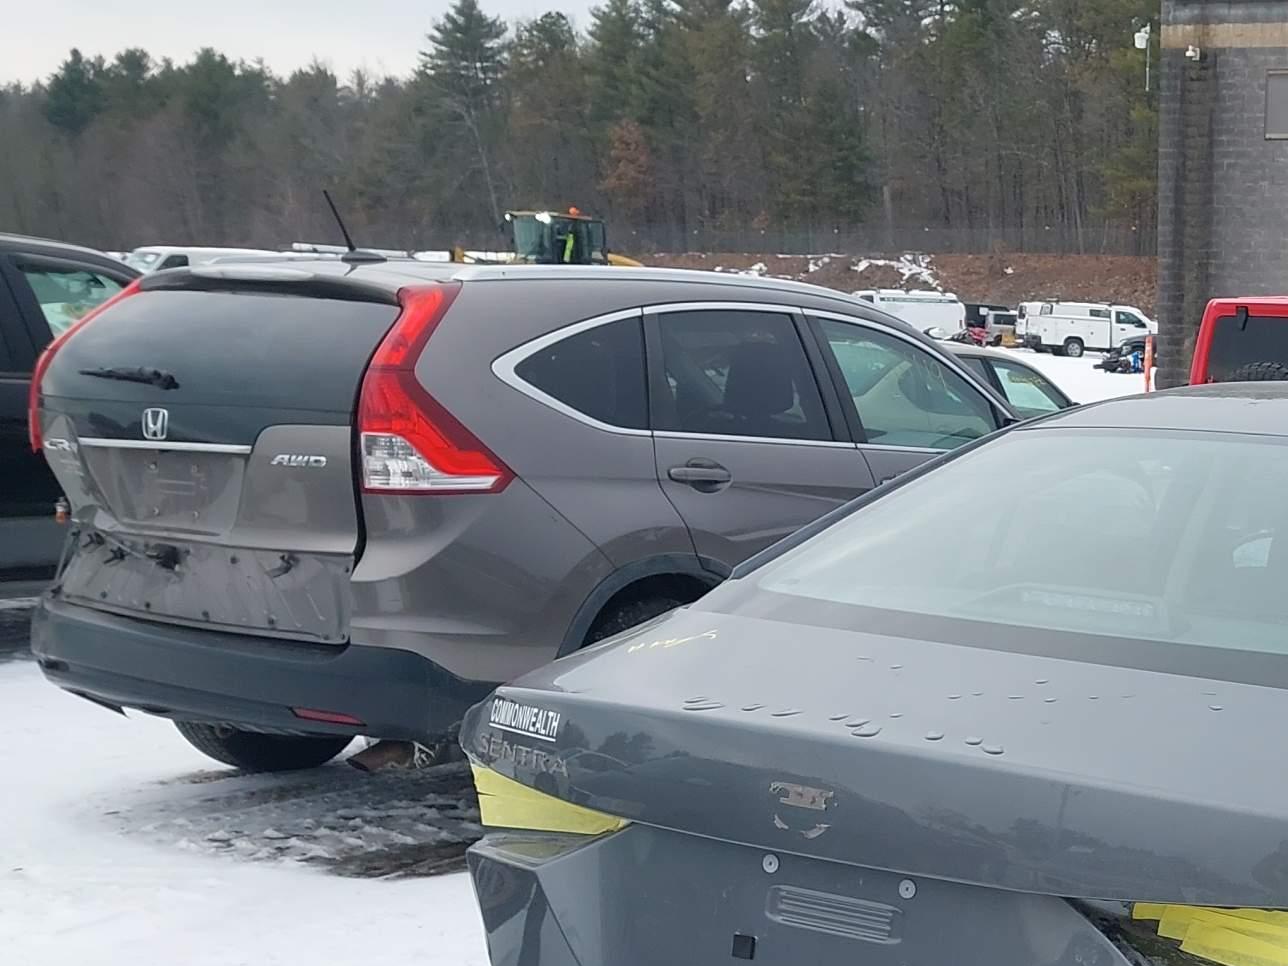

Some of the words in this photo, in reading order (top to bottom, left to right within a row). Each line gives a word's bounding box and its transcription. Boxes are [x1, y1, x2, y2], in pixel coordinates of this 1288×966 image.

[270, 454, 327, 467] AWD
[489, 698, 561, 737] COMMONWEALTH
[479, 732, 569, 777] SENTRA
